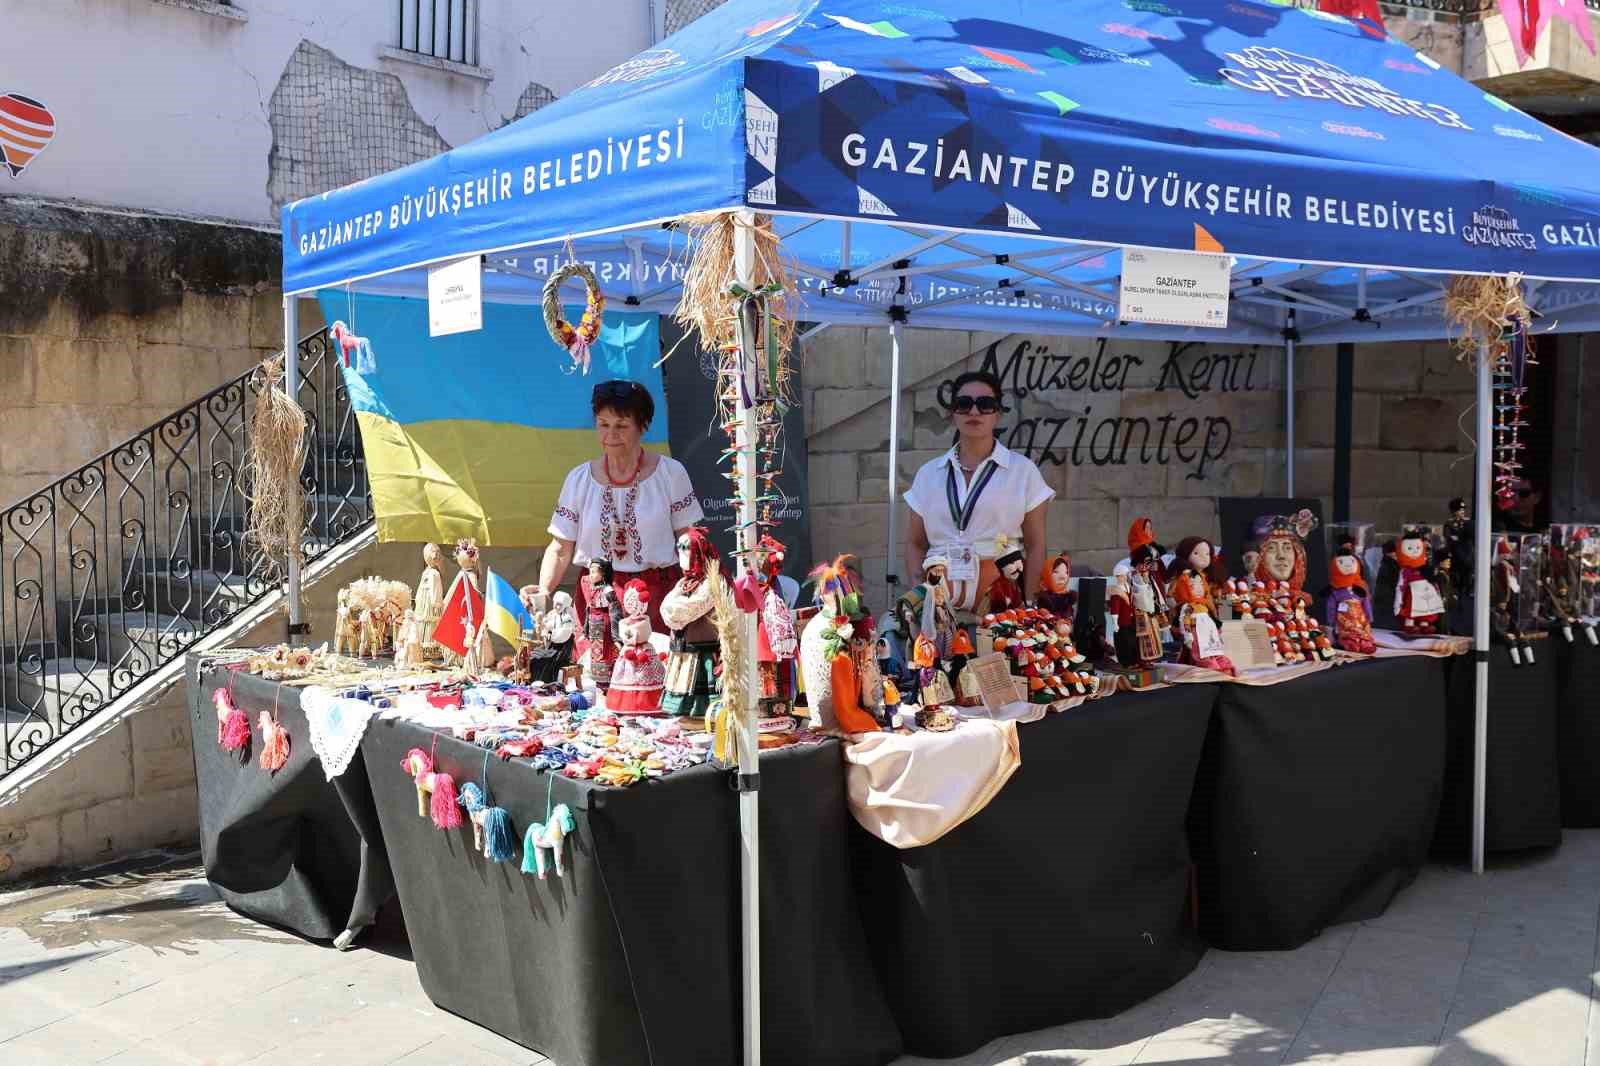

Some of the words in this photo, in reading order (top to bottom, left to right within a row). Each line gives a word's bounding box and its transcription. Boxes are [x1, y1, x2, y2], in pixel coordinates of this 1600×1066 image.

[300, 209, 382, 257] GAZİANTEP
[389, 168, 512, 227] BÜYÜKŞEHİR
[523, 117, 685, 196] BELEDİYESİ
[842, 132, 1075, 194] GAZİANTEP
[1091, 164, 1292, 219] BÜYÜKŞEHİR
[1305, 194, 1456, 236] BELEDİYESİ
[1542, 222, 1600, 248] GAZİ
[1156, 276, 1198, 288] GAZİANTEP
[974, 337, 1143, 399] Müzeler
[1155, 340, 1259, 399] Kenti
